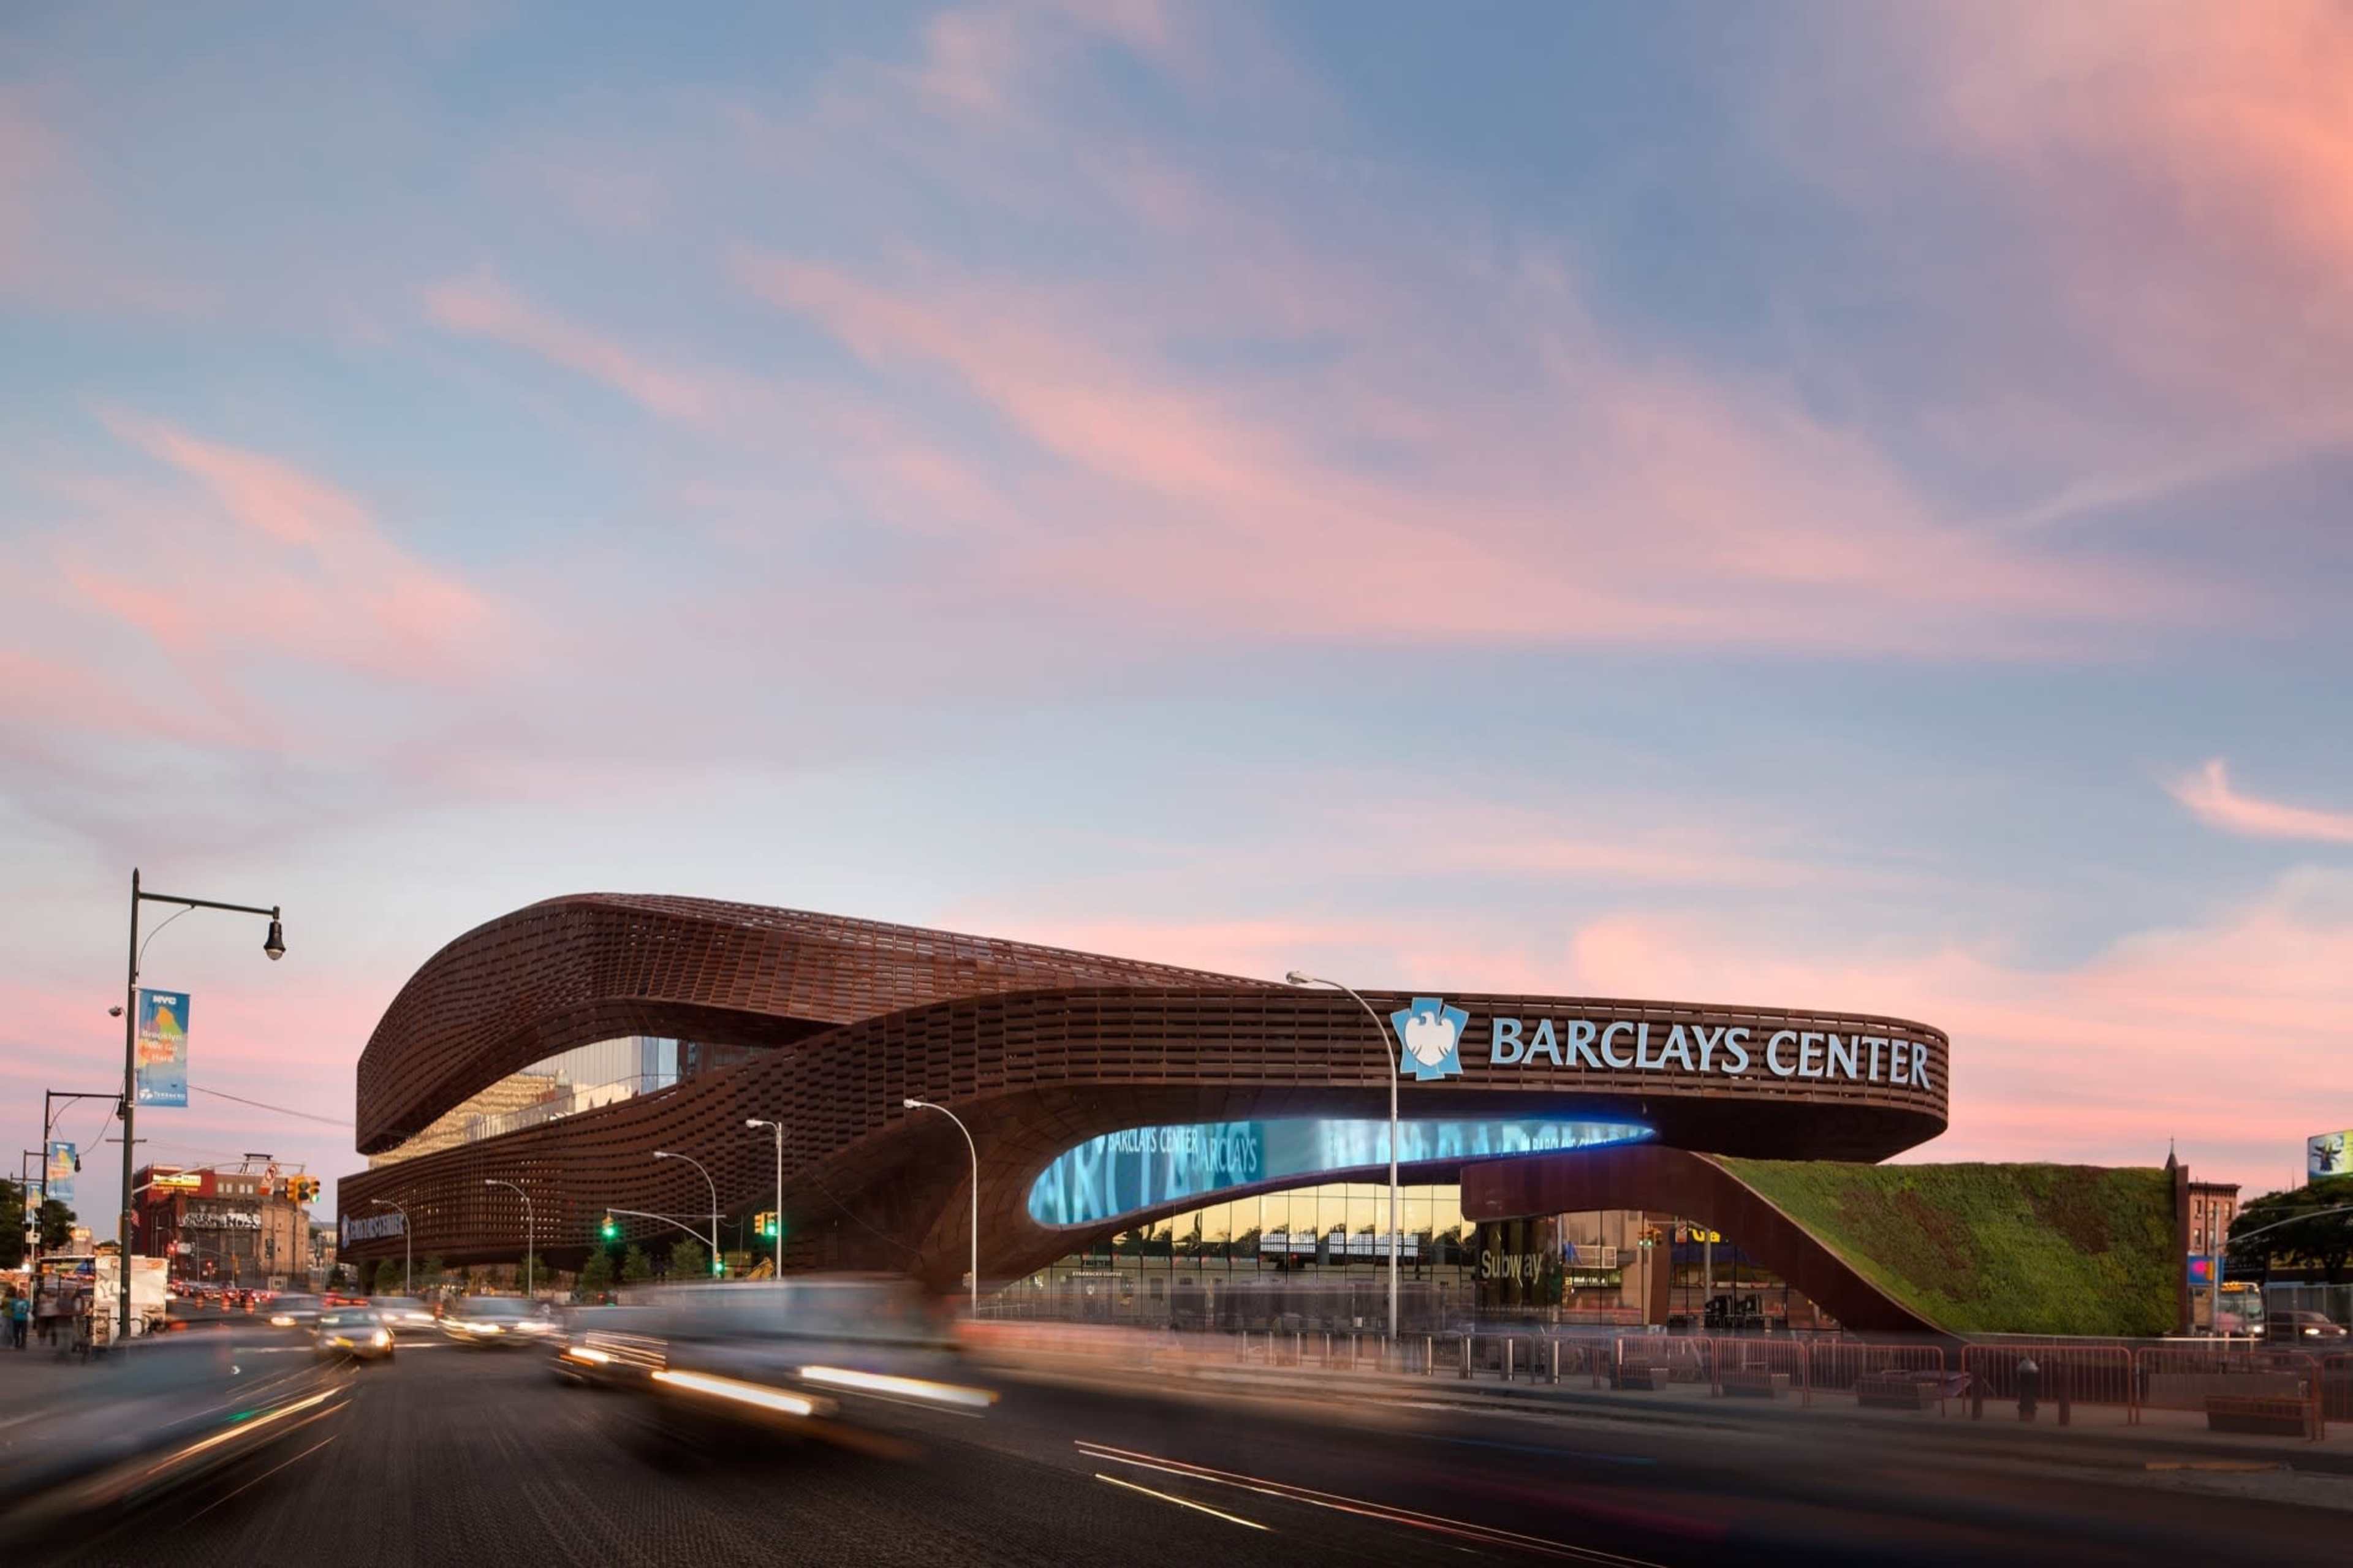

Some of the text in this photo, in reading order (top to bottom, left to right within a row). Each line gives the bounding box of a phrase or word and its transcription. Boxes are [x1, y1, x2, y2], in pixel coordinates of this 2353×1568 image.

[153, 995, 177, 1006] NYC
[1490, 1017, 1931, 1090] BARCLAYS CENTER
[1108, 1127, 1199, 1154] BARCLAYS CENTER
[1481, 1249, 1542, 1284] Subway
